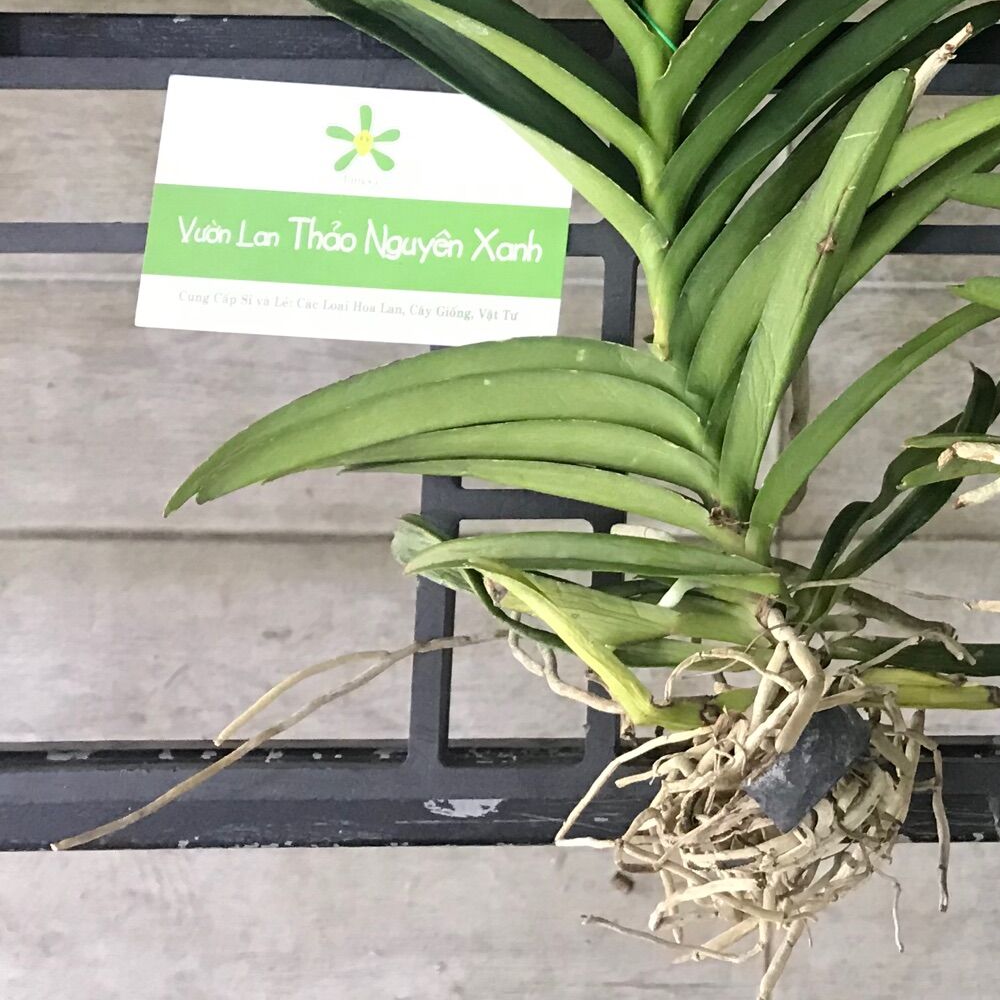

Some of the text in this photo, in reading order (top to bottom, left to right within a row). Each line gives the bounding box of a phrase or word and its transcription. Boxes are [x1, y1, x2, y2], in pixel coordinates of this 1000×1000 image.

[236, 219, 280, 247] Lan
[288, 216, 357, 253] Thảo
[364, 218, 463, 264] Nguyên
[470, 227, 543, 264] Xanh
